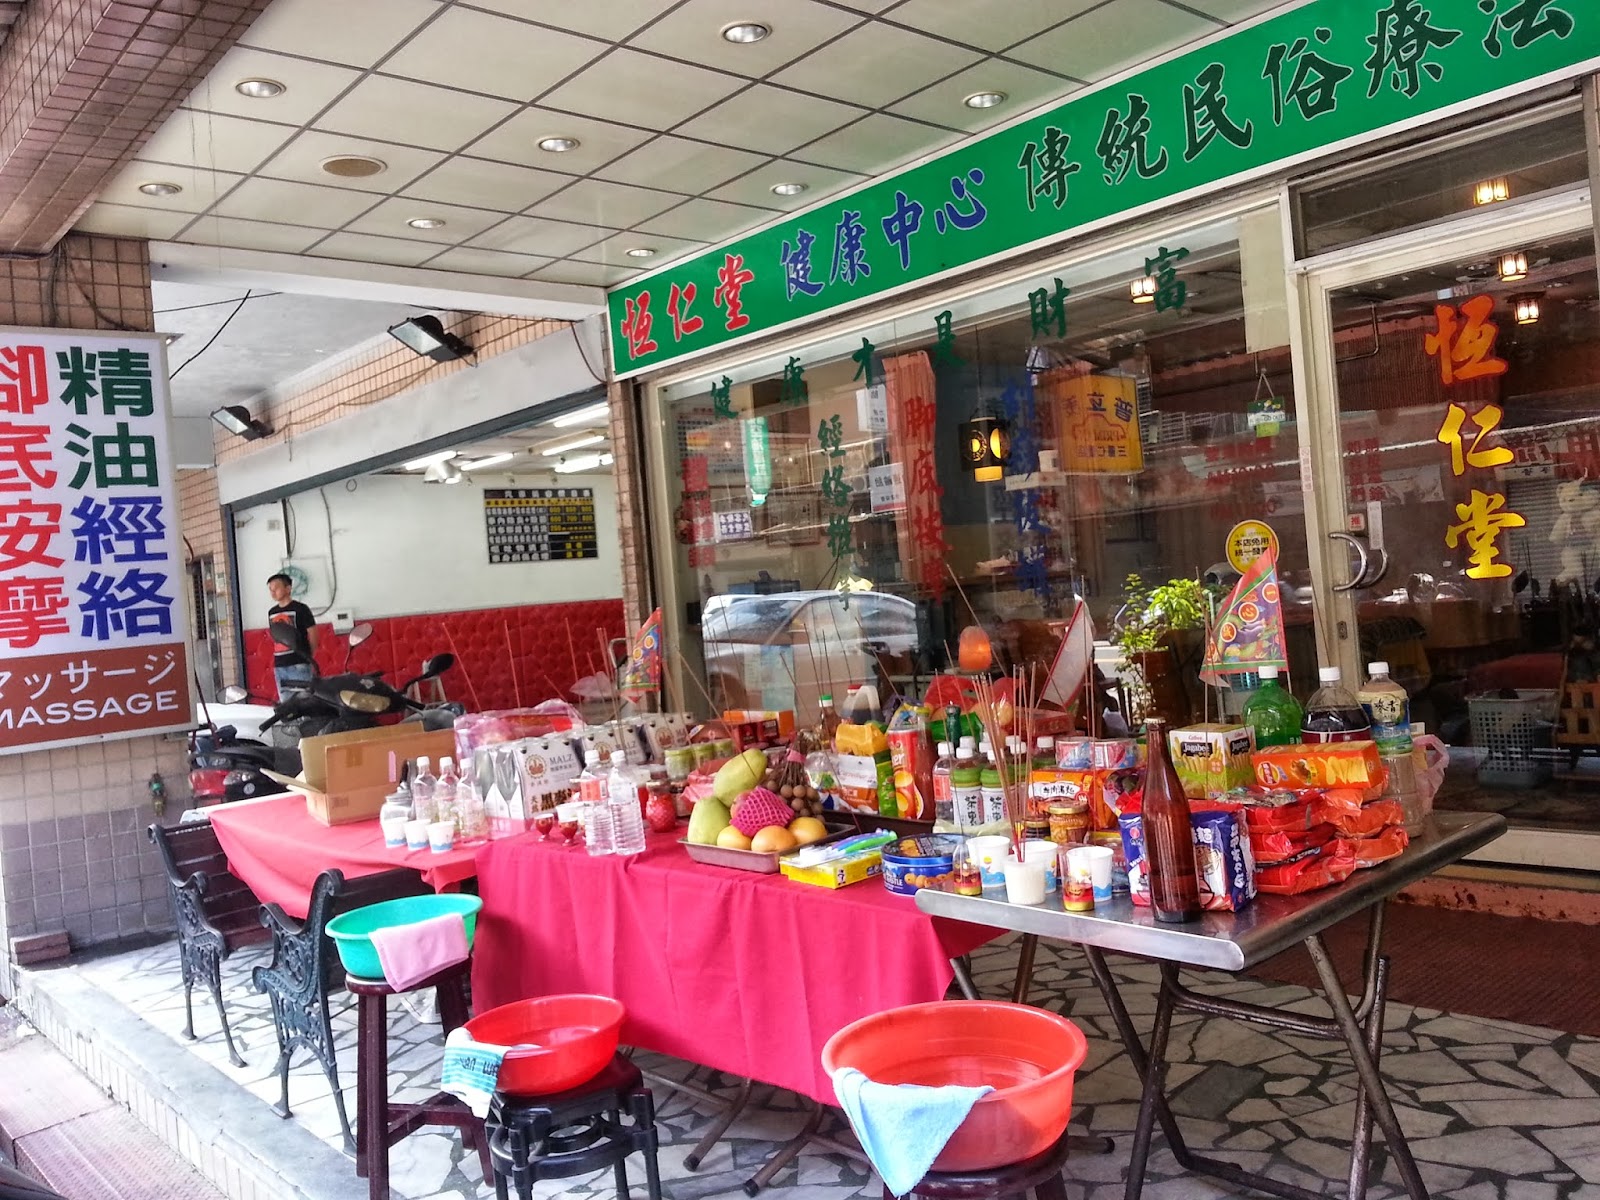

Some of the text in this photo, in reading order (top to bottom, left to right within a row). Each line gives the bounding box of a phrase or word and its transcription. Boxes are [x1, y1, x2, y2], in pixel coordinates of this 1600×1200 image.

[780, 167, 987, 301] 健康中心
[1018, 0, 1575, 212] 傳統民俗療法
[710, 246, 1190, 421] 健康才是財富
[55, 345, 175, 641] 精油經絡
[1234, 536, 1270, 547] 本店免用
[549, 752, 574, 765] MALZ
[1183, 742, 1210, 752] Jagabee
